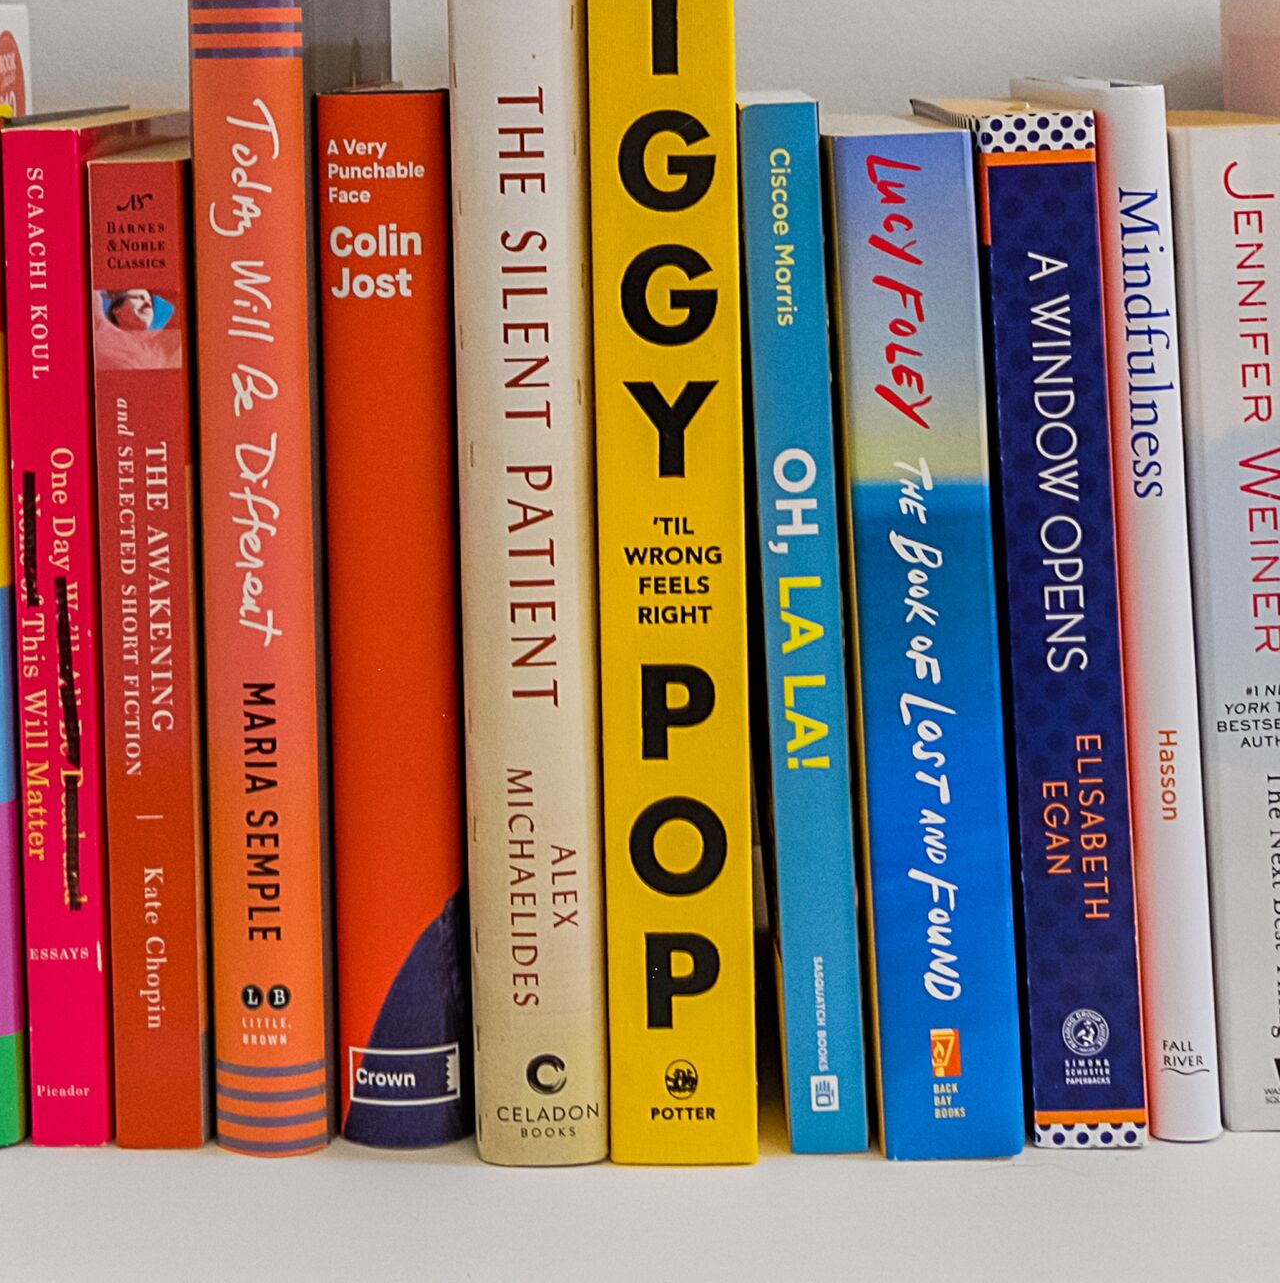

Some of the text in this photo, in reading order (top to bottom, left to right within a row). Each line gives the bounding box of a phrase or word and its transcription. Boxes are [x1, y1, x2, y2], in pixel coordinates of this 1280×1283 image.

[326, 137, 388, 159] A Very
[327, 160, 426, 180] Punchable
[328, 186, 371, 205] Face
[328, 222, 423, 258] Colin
[769, 147, 799, 327] Ciscoe Morris
[25, 166, 51, 380] SCAACHI KOUL
[331, 265, 413, 300] Jost
[1222, 160, 1276, 424] JENNIFER
[209, 98, 284, 648] Today Will Be Different
[1117, 186, 1176, 500] Mindfulness
[496, 86, 560, 709] THE SILENT PATIENT
[49, 446, 76, 505] One
[1026, 251, 1089, 674] A WINDOW OPENS
[48, 516, 78, 573] Day
[623, 545, 724, 567] WRONG
[115, 398, 143, 778] and SELECTED SHORT FICTION
[144, 440, 176, 733] THE AWAKENING
[637, 605, 713, 626] RIGHT
[638, 575, 711, 596] FEELS
[767, 447, 831, 770] OH, LA LA!
[21, 613, 46, 679] This
[24, 688, 49, 750] Will
[1224, 701, 1272, 715] YORK
[1245, 684, 1261, 697] #1
[1157, 729, 1179, 822] Hasson
[26, 760, 51, 861] Matter
[242, 682, 282, 942] MARIA SEMPLE
[1041, 781, 1073, 877] EGAN
[1074, 733, 1112, 921] ELISABETH
[628, 662, 728, 1031] POP
[506, 767, 540, 1008] MICHAELIDES
[550, 843, 580, 929] ALEX
[29, 946, 90, 962] ESSAYS
[139, 867, 169, 1030] Kate Chopin
[813, 956, 830, 1072] SASQUATCH BOOKS
[1162, 1039, 1195, 1053] FALL
[36, 1083, 91, 1099] Picador
[355, 1067, 417, 1089] Crown
[1163, 1053, 1205, 1069] RIVER
[496, 1102, 600, 1123] CELADON
[520, 1126, 577, 1139] BOOKS
[650, 1107, 717, 1121] POTTER
